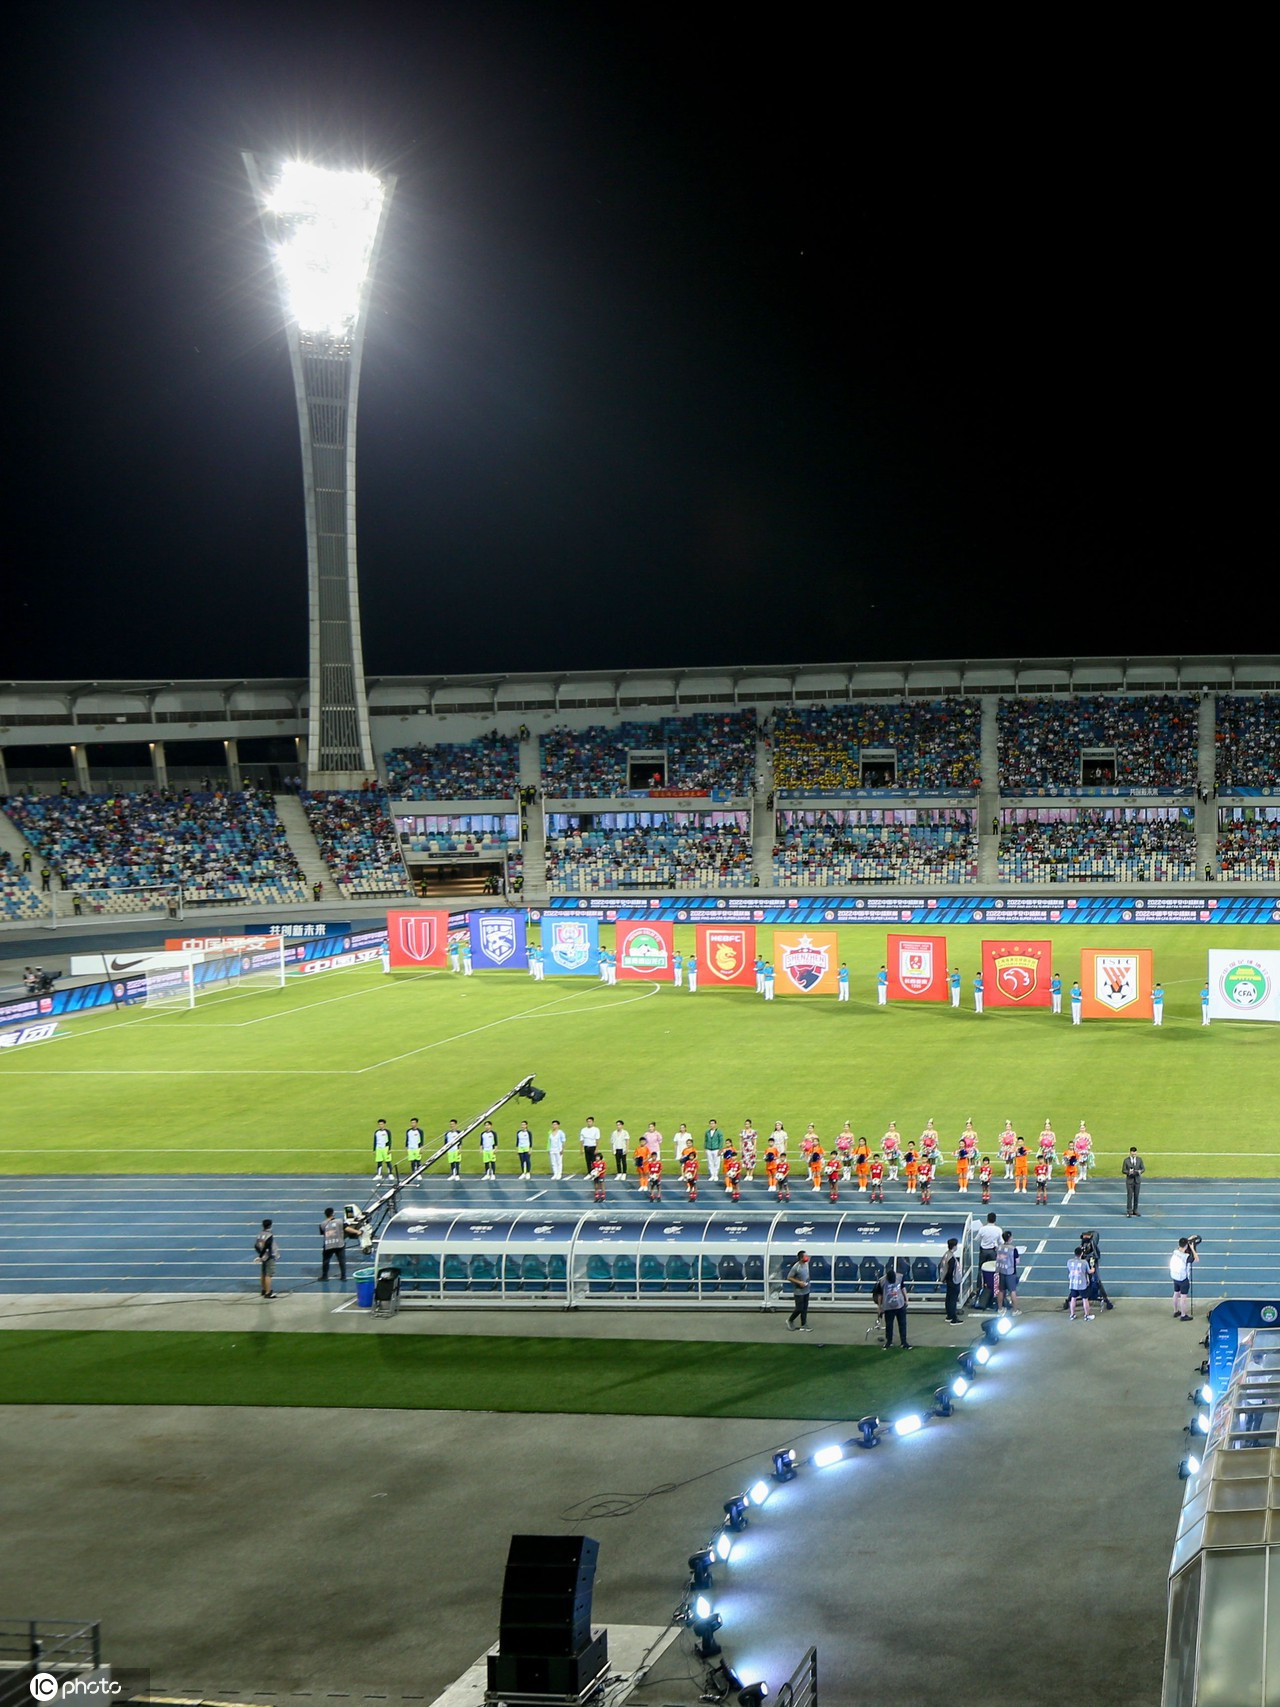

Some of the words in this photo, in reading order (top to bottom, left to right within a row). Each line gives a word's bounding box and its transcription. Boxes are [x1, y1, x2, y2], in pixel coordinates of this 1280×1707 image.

[269, 924, 326, 936] 共创新未来
[710, 934, 742, 943] HEBFC
